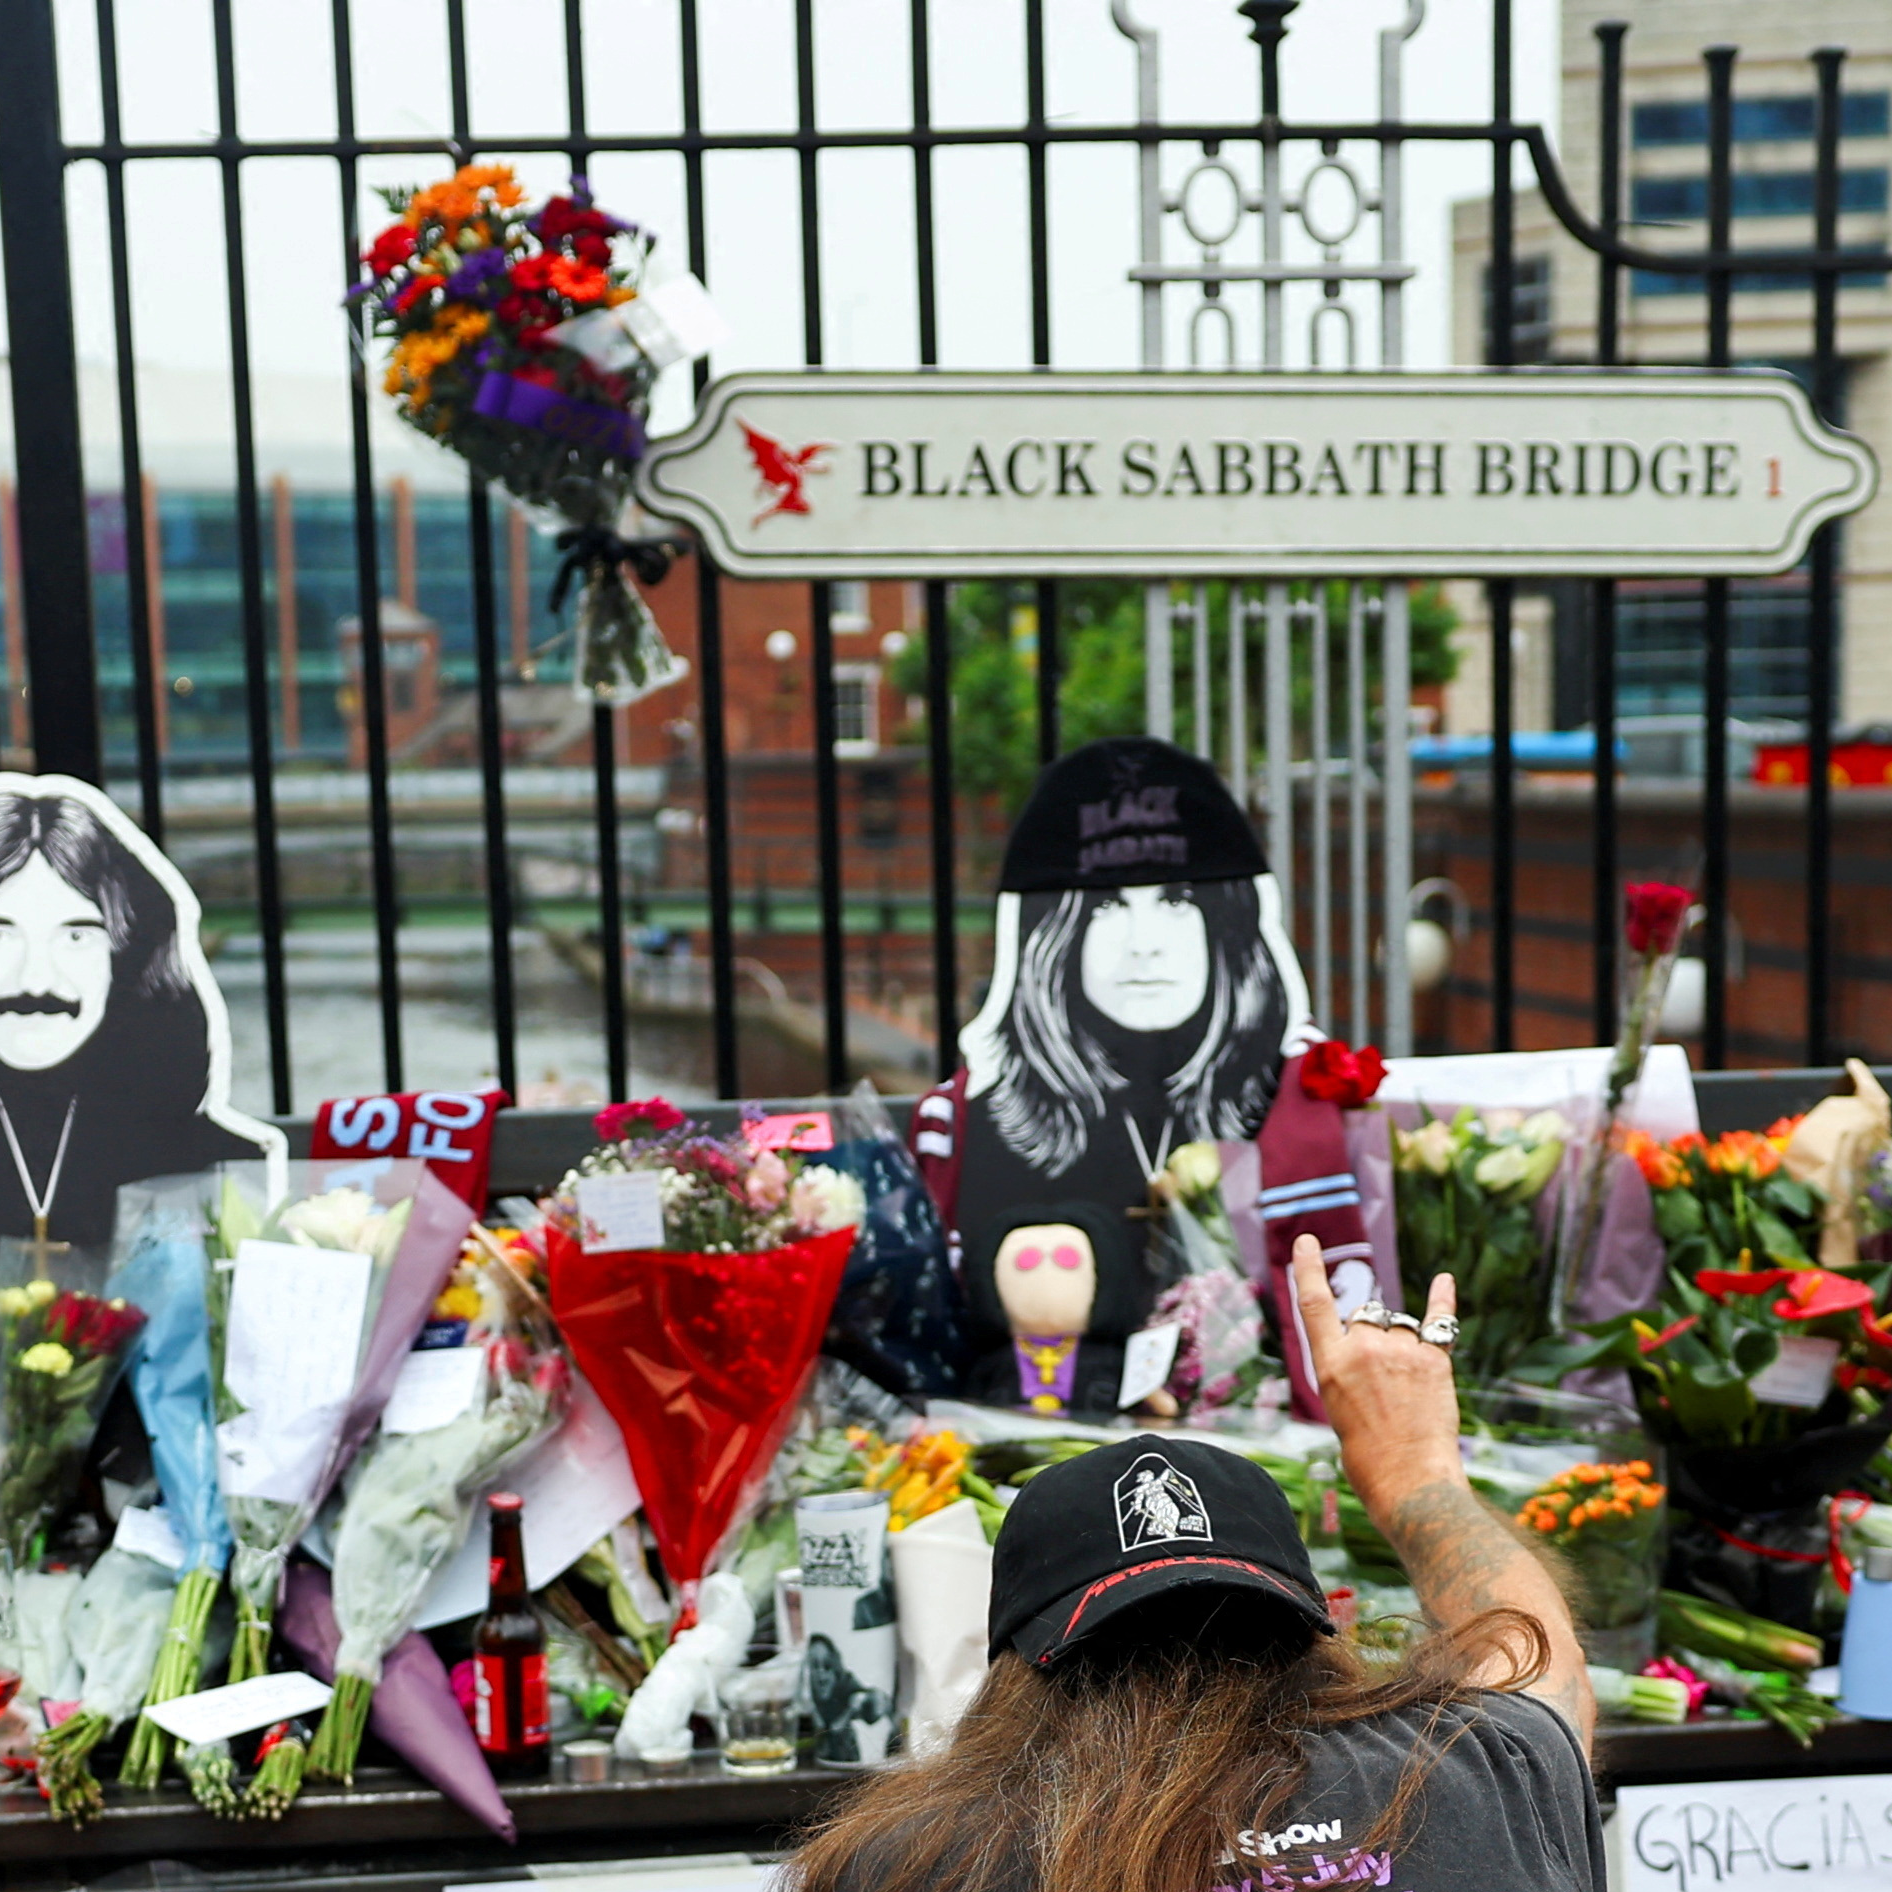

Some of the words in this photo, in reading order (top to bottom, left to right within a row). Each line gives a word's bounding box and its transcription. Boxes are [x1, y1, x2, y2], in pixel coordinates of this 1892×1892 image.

[860, 439, 1098, 498] BLACK
[1121, 439, 1451, 498] SABBATH
[1473, 439, 1739, 499] BRIDGE
[1767, 457, 1783, 499] 1
[1236, 1818, 1343, 1857] Show
[1302, 1846, 1392, 1887] July
